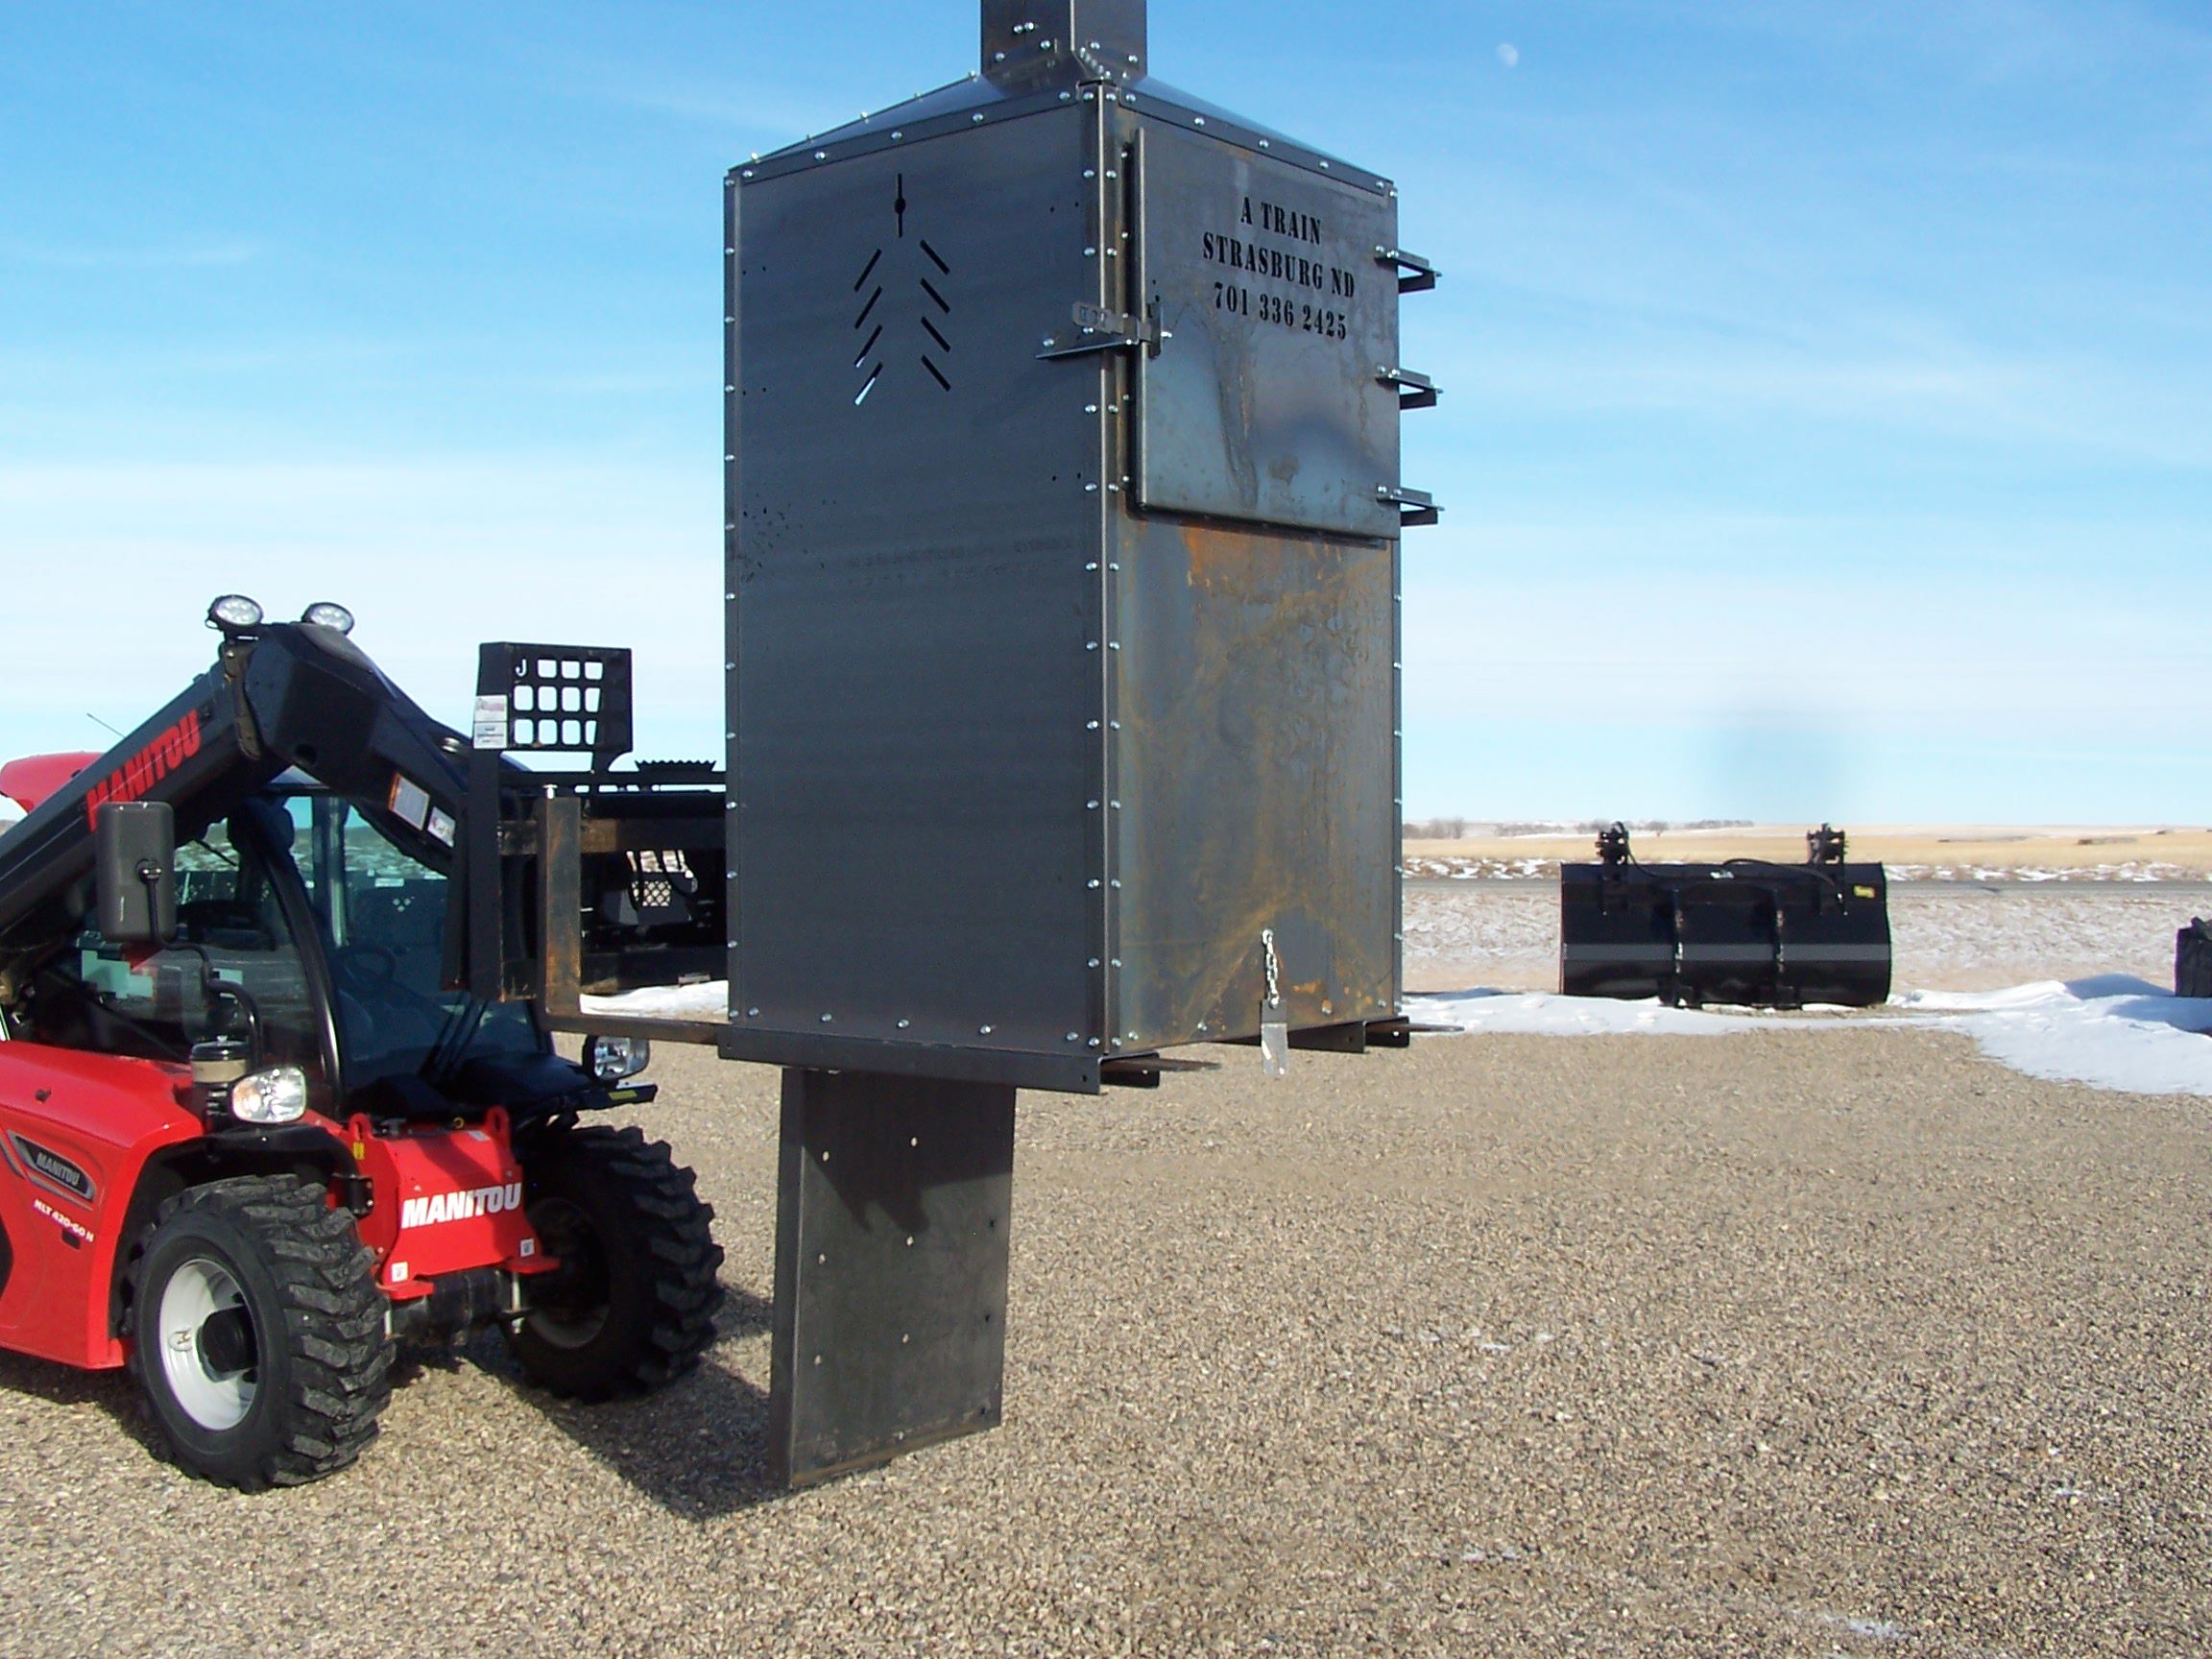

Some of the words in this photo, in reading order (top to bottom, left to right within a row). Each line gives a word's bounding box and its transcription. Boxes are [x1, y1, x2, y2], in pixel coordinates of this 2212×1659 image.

[1240, 197, 1253, 225] A
[1261, 202, 1321, 245] TRAIN
[1203, 231, 1323, 290] STRASBURG
[1331, 267, 1355, 298] ND
[1214, 281, 1248, 316] 701
[1260, 294, 1294, 327] 336
[1303, 304, 1346, 340] 2425
[36, 1152, 81, 1187] MANITOU
[400, 1182, 521, 1229] MANITOU
